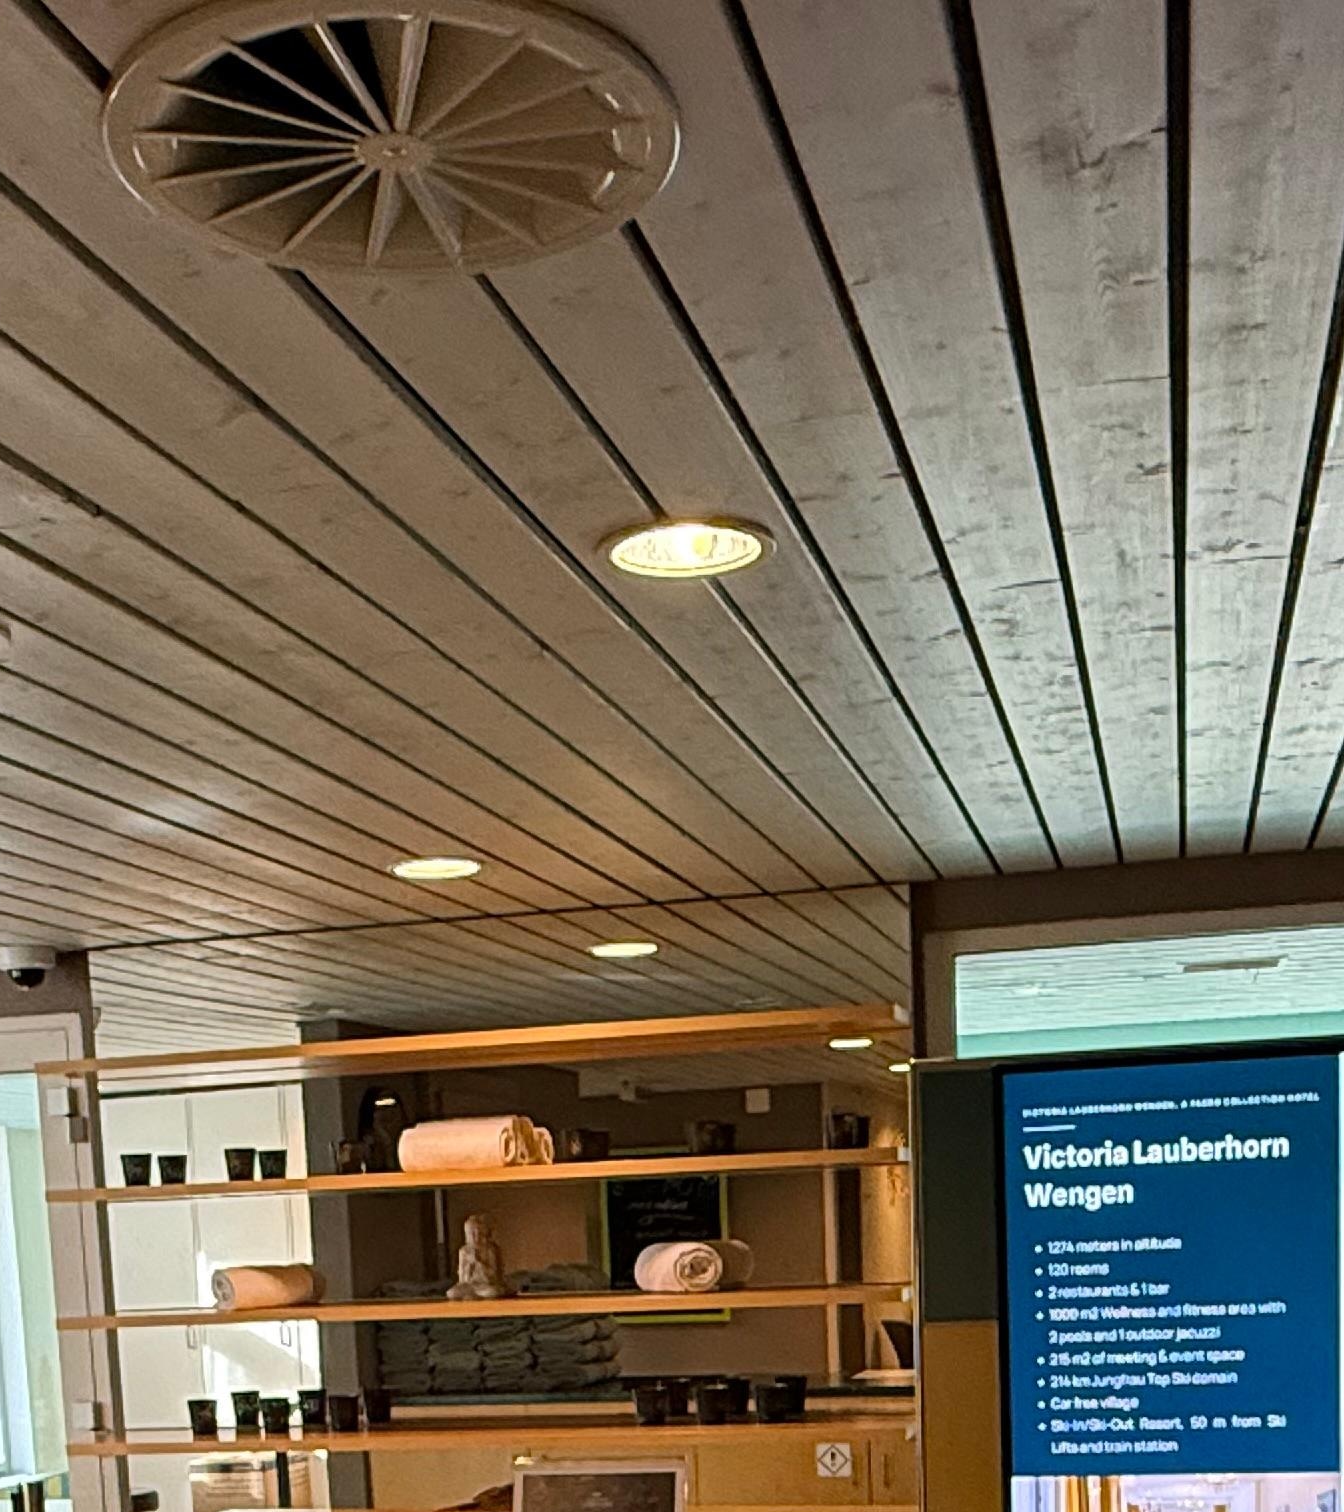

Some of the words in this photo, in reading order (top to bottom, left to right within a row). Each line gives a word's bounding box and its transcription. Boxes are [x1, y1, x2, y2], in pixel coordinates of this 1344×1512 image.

[1022, 1140, 1129, 1170] Victoria
[1132, 1134, 1290, 1165] Lauberhorn
[1024, 1182, 1134, 1211] Wengen
[1121, 1238, 1133, 1252] in
[1134, 1237, 1182, 1251] altitude
[1070, 1263, 1110, 1276] rooms
[1048, 1285, 1057, 1299] 2
[1057, 1284, 1129, 1298] restaurants
[1141, 1281, 1147, 1296] 1
[1148, 1282, 1170, 1296] bar
[1099, 1305, 1157, 1319] Wellness
[1157, 1305, 1182, 1318] and
[1182, 1303, 1226, 1317] fitness
[1228, 1303, 1256, 1316] area
[1258, 1301, 1287, 1314] with
[1048, 1330, 1058, 1344] 2
[1058, 1330, 1093, 1346] pools
[1094, 1329, 1118, 1343] and
[1118, 1328, 1125, 1342] 1
[1125, 1328, 1175, 1342] outdoor
[1175, 1326, 1221, 1342] jacuzzi
[1092, 1350, 1106, 1365] of
[1106, 1351, 1157, 1367] meeting
[1158, 1348, 1168, 1363] &
[1169, 1350, 1205, 1363] event
[1206, 1350, 1246, 1364] space
[1072, 1374, 1091, 1388] km
[1091, 1373, 1146, 1390] Jungfrau
[1147, 1372, 1171, 1388] Top
[1171, 1371, 1191, 1385] Ski
[1192, 1371, 1238, 1385] domain
[1099, 1396, 1140, 1411] village
[1212, 1417, 1227, 1428] m
[1231, 1414, 1262, 1428] from
[1267, 1414, 1287, 1428] Ski
[1050, 1440, 1079, 1454] Lifts
[1079, 1440, 1103, 1453] and
[1104, 1440, 1133, 1452] train
[1134, 1439, 1179, 1452] station
